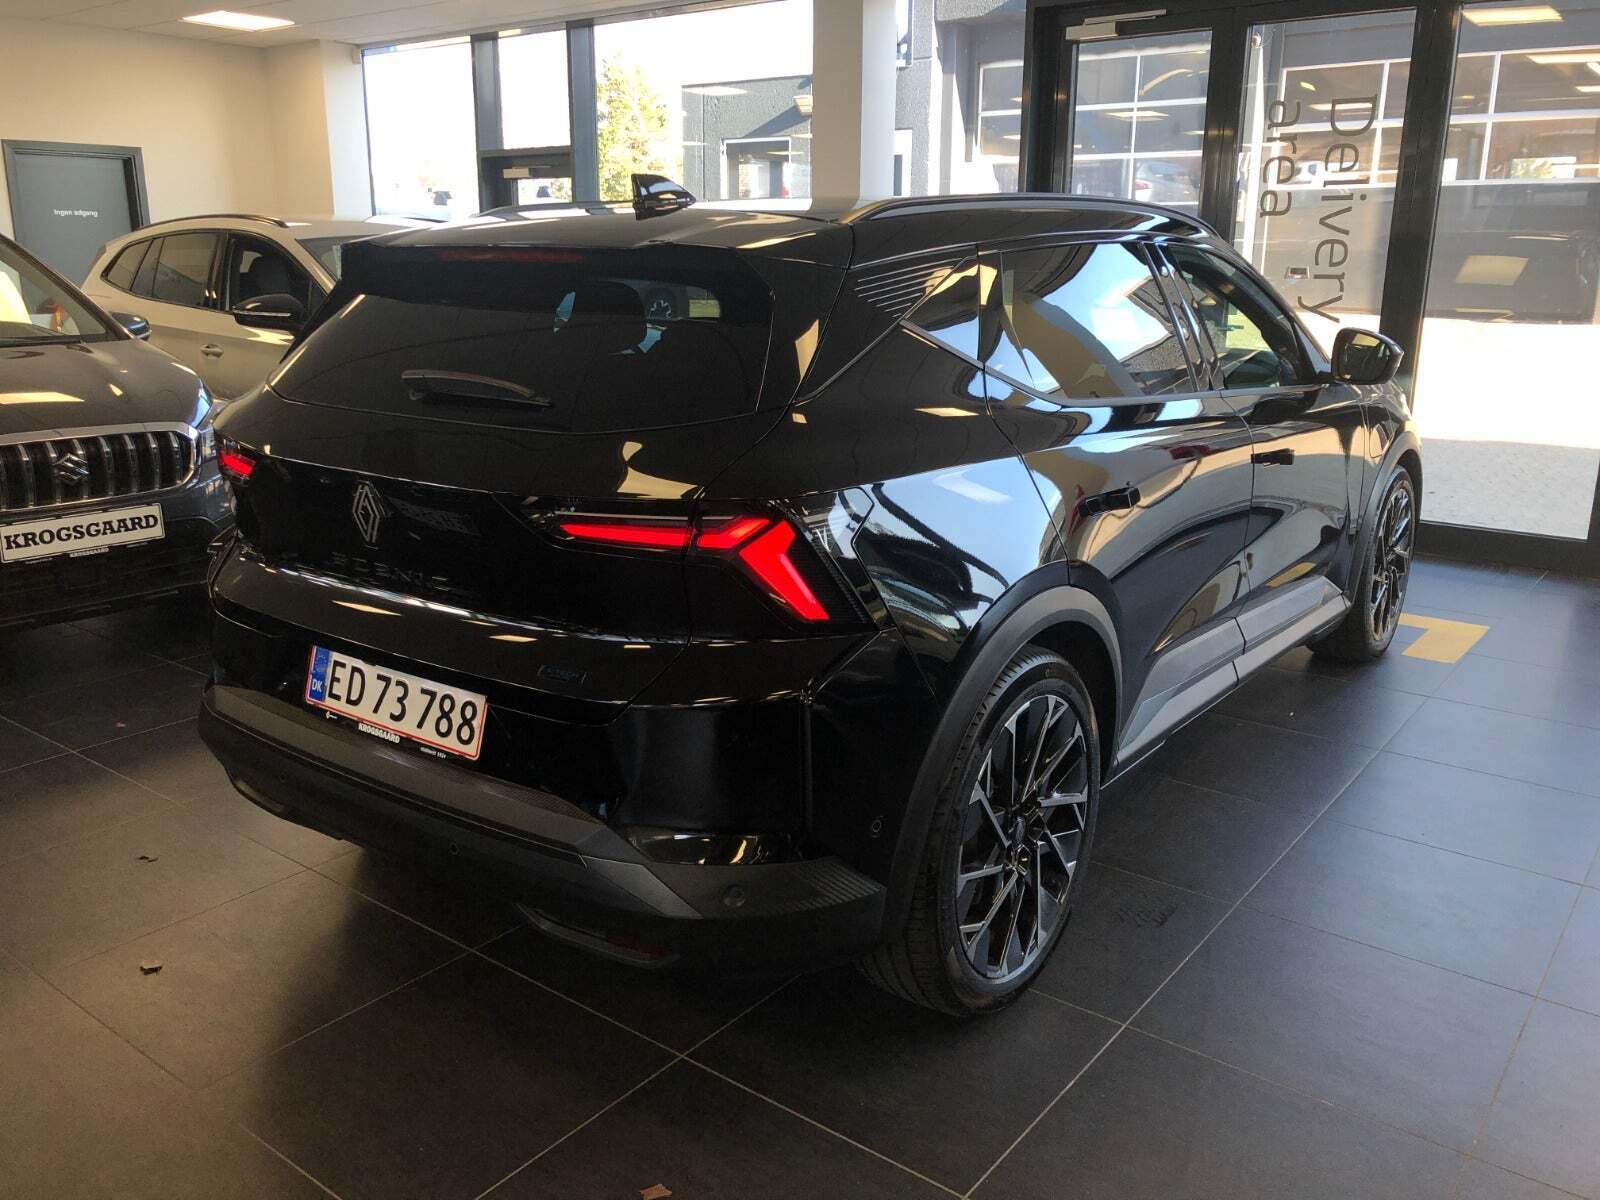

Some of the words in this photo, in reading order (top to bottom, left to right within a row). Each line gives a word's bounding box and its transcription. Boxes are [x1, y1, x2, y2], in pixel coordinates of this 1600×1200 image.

[1259, 101, 1301, 218] area
[1298, 94, 1378, 323] Delivery
[4, 514, 159, 550] KROGSGAARD
[311, 678, 323, 693] DK
[327, 659, 366, 707] ED
[372, 673, 410, 723] 73
[416, 686, 479, 746] 788
[358, 721, 401, 744] KROGSGAARD
